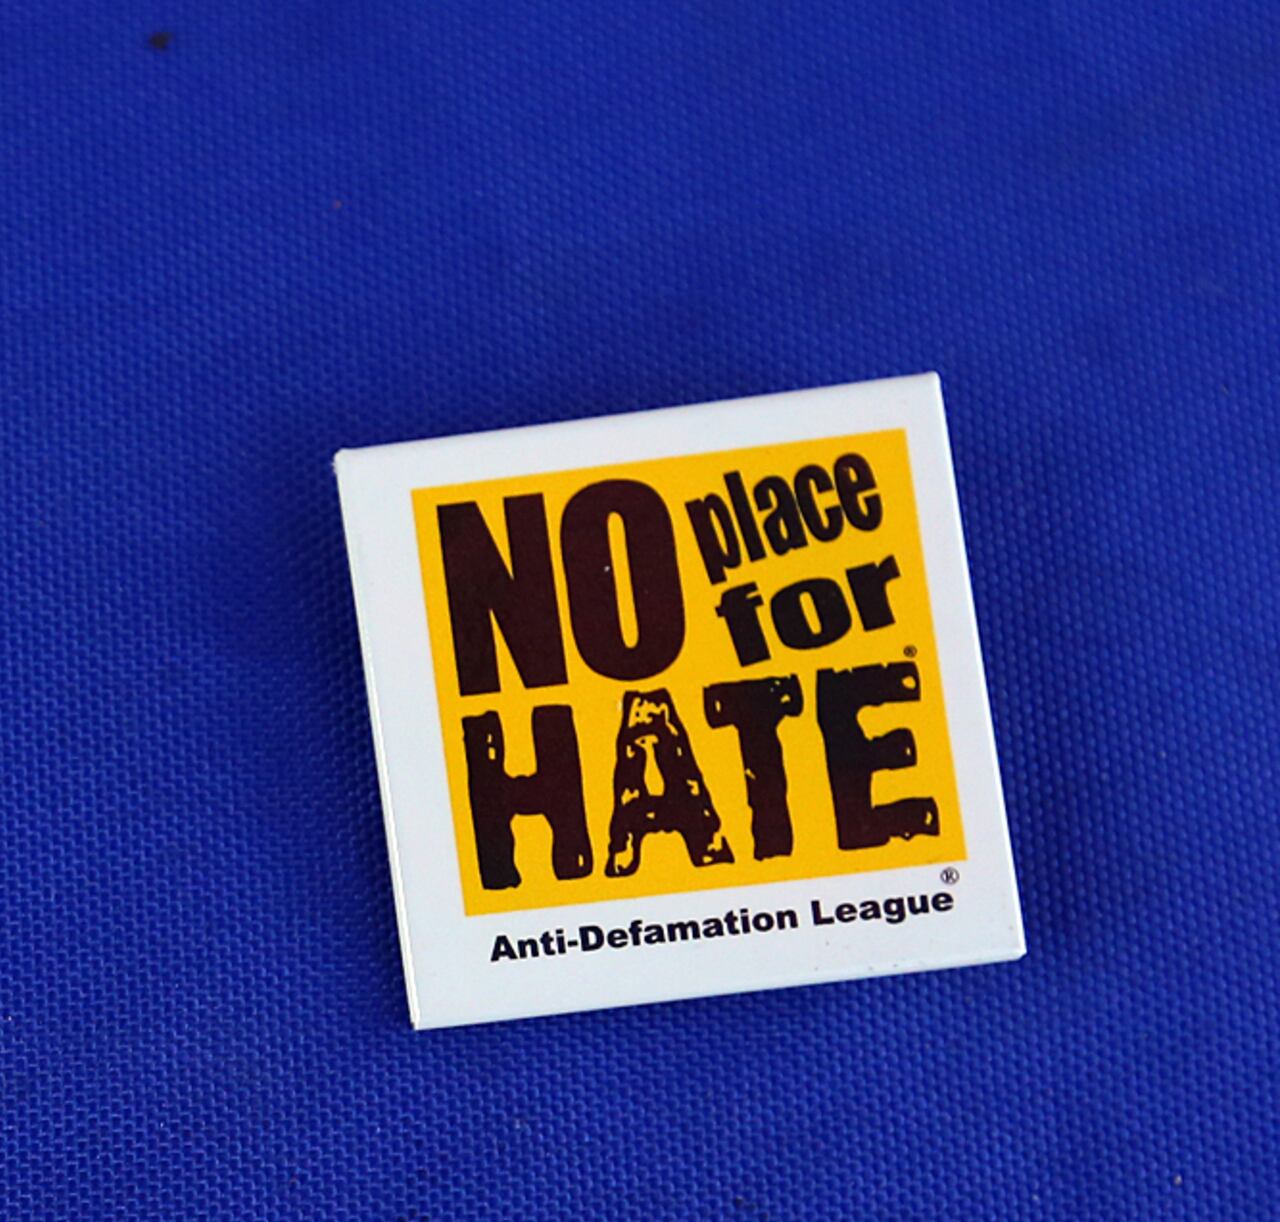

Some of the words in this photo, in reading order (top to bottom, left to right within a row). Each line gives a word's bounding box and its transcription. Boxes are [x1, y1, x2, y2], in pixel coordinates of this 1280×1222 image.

[436, 478, 686, 696] NO
[684, 452, 882, 583] place
[715, 555, 900, 667] for
[490, 908, 799, 962] Anti-Defamation
